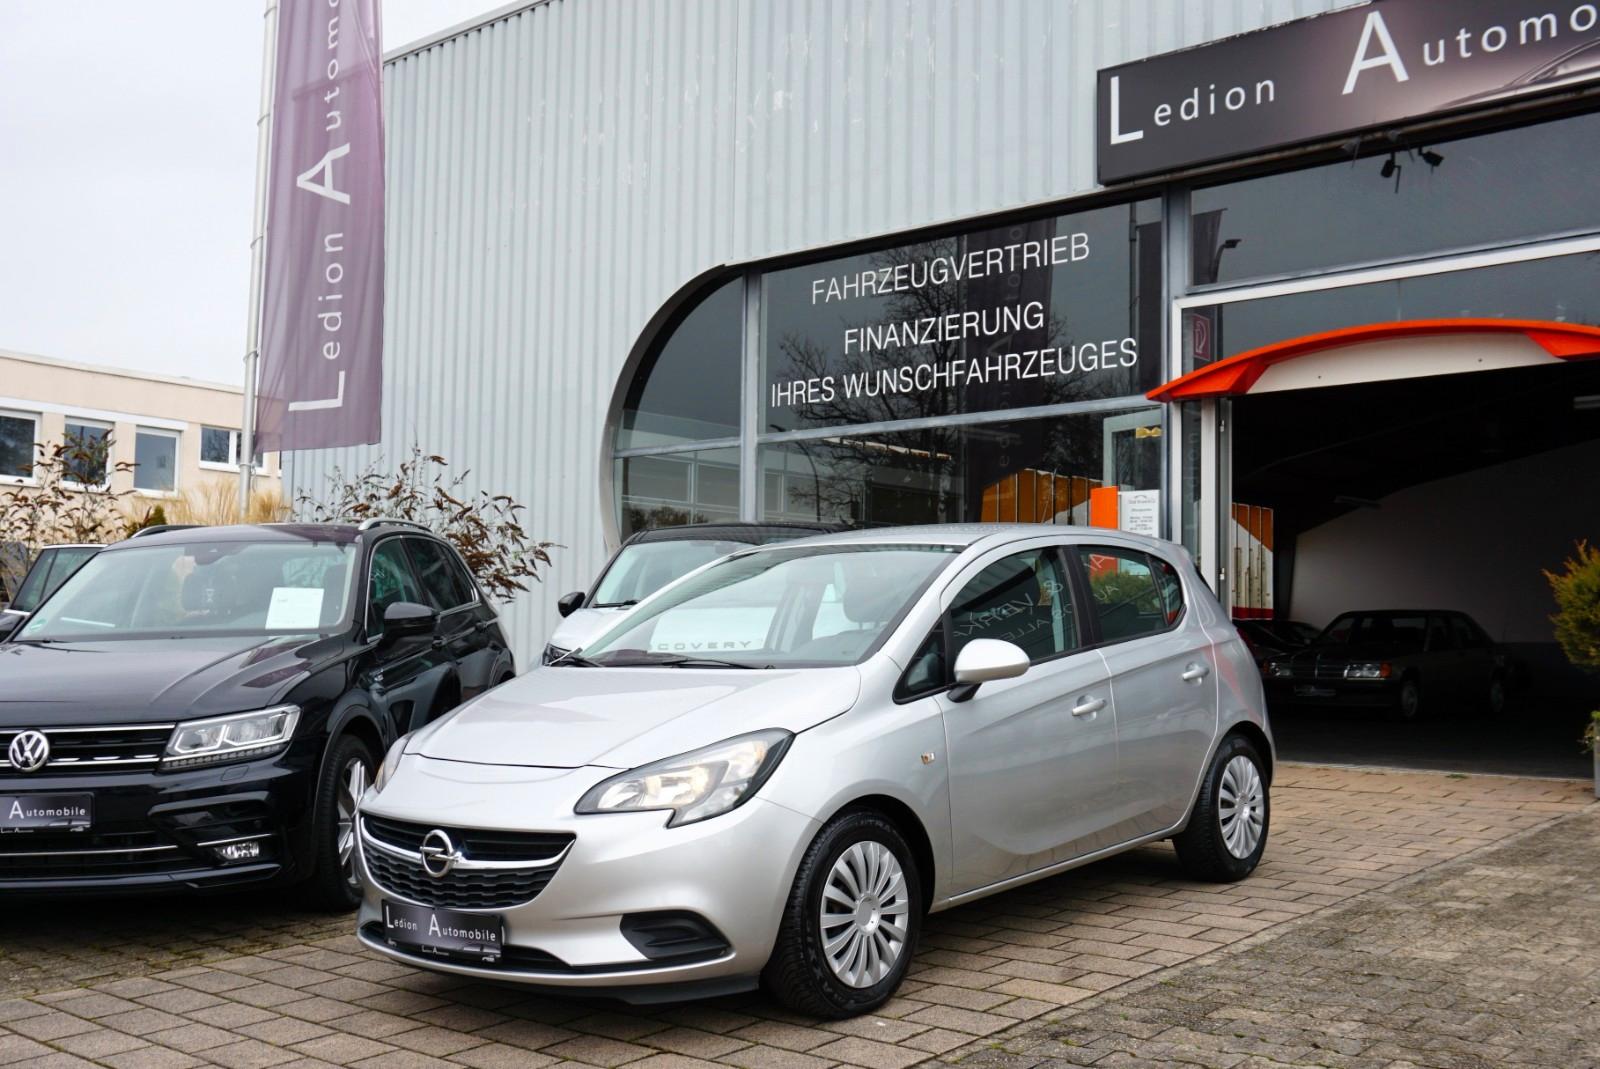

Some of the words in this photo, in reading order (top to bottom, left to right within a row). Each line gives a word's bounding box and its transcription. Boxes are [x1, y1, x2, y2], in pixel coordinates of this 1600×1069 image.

[1109, 75, 1276, 145] Ledion
[1342, 4, 1598, 94] Automo
[812, 232, 1090, 305] FAHRZEUGVERTRIEB
[288, 232, 346, 413] Ledion
[844, 301, 1044, 355] FINANZIERUNG
[771, 375, 835, 408] IHRES
[843, 337, 1138, 399] WUNSCHFAHRZEUGES
[650, 640, 752, 651] COVERY
[8, 800, 86, 819] Automobile
[385, 905, 418, 931] Ledion
[428, 913, 497, 942] Automobile
